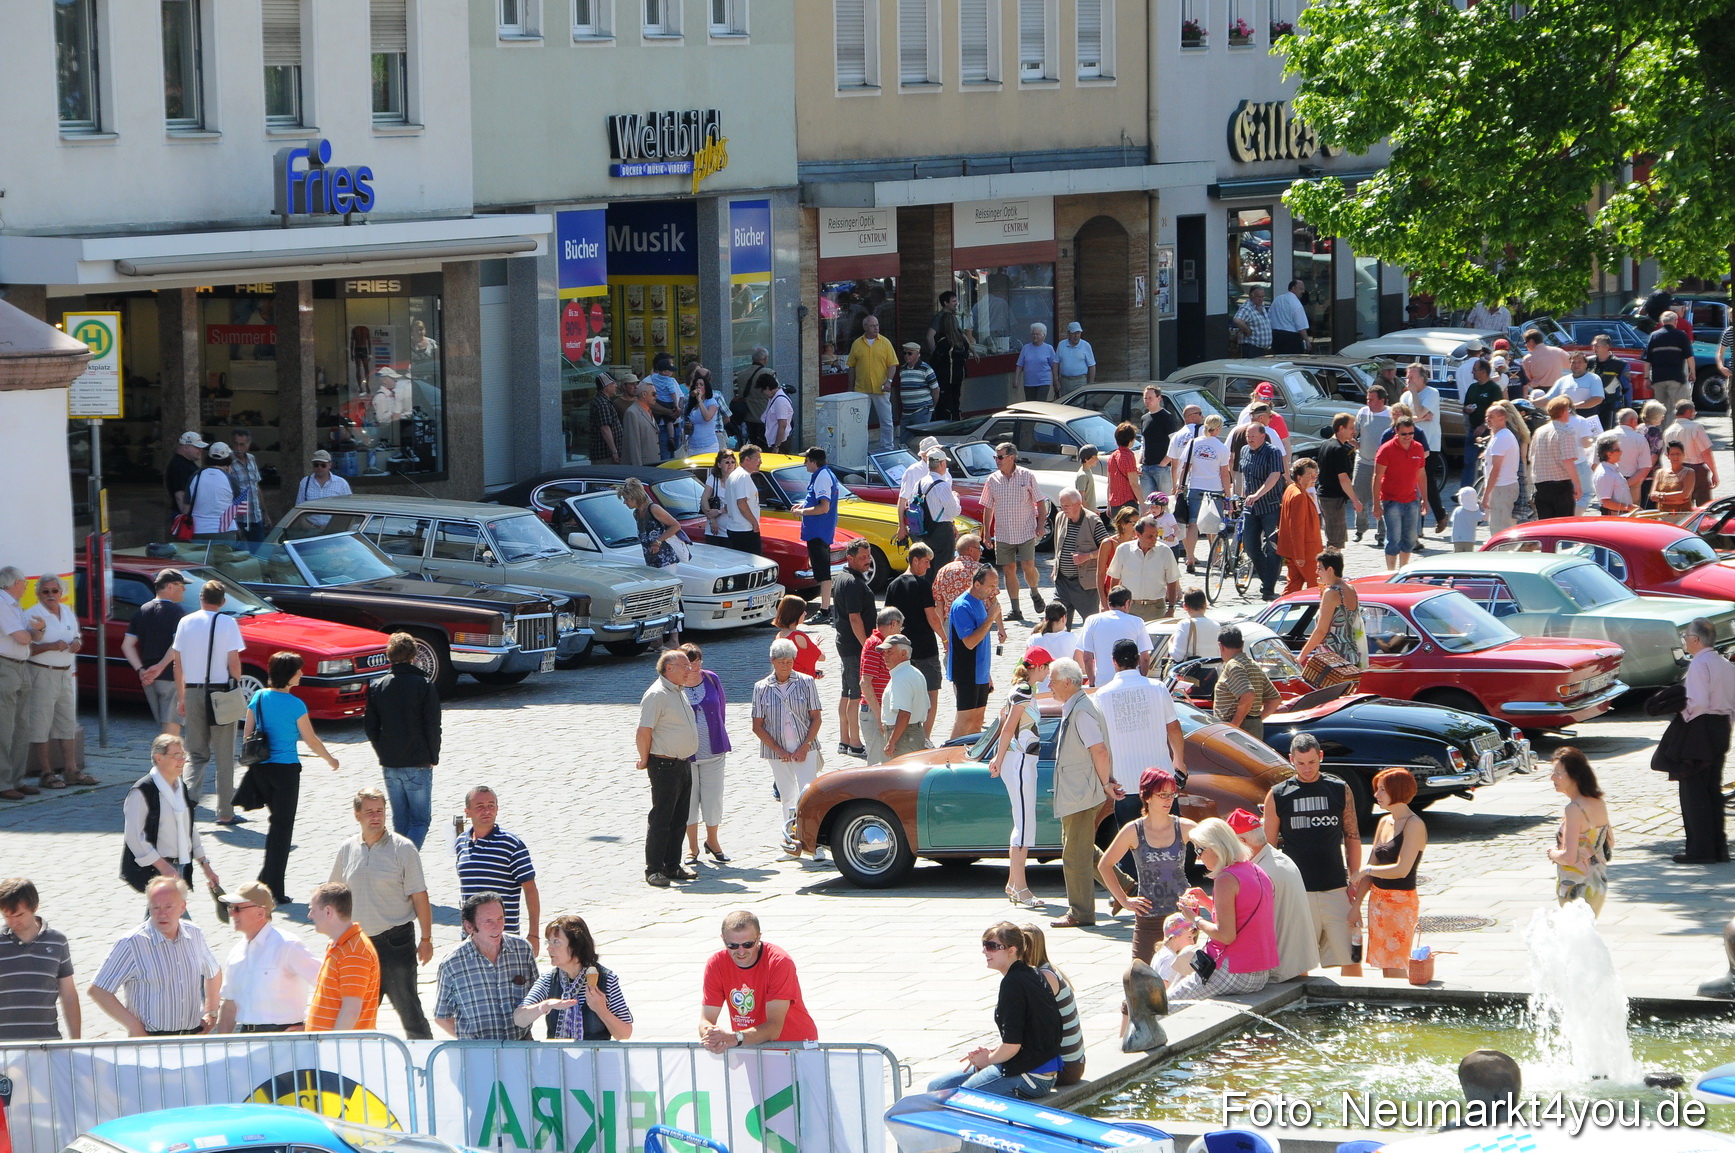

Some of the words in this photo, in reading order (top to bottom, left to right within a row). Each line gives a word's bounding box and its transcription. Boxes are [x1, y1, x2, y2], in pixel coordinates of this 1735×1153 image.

[610, 109, 721, 159] Weltbild
[280, 139, 375, 215] fries
[565, 237, 599, 260] Bücher
[607, 223, 686, 253] Musik
[735, 226, 765, 248] Bücher
[345, 280, 401, 293] FRIES
[212, 329, 266, 344] Summer
